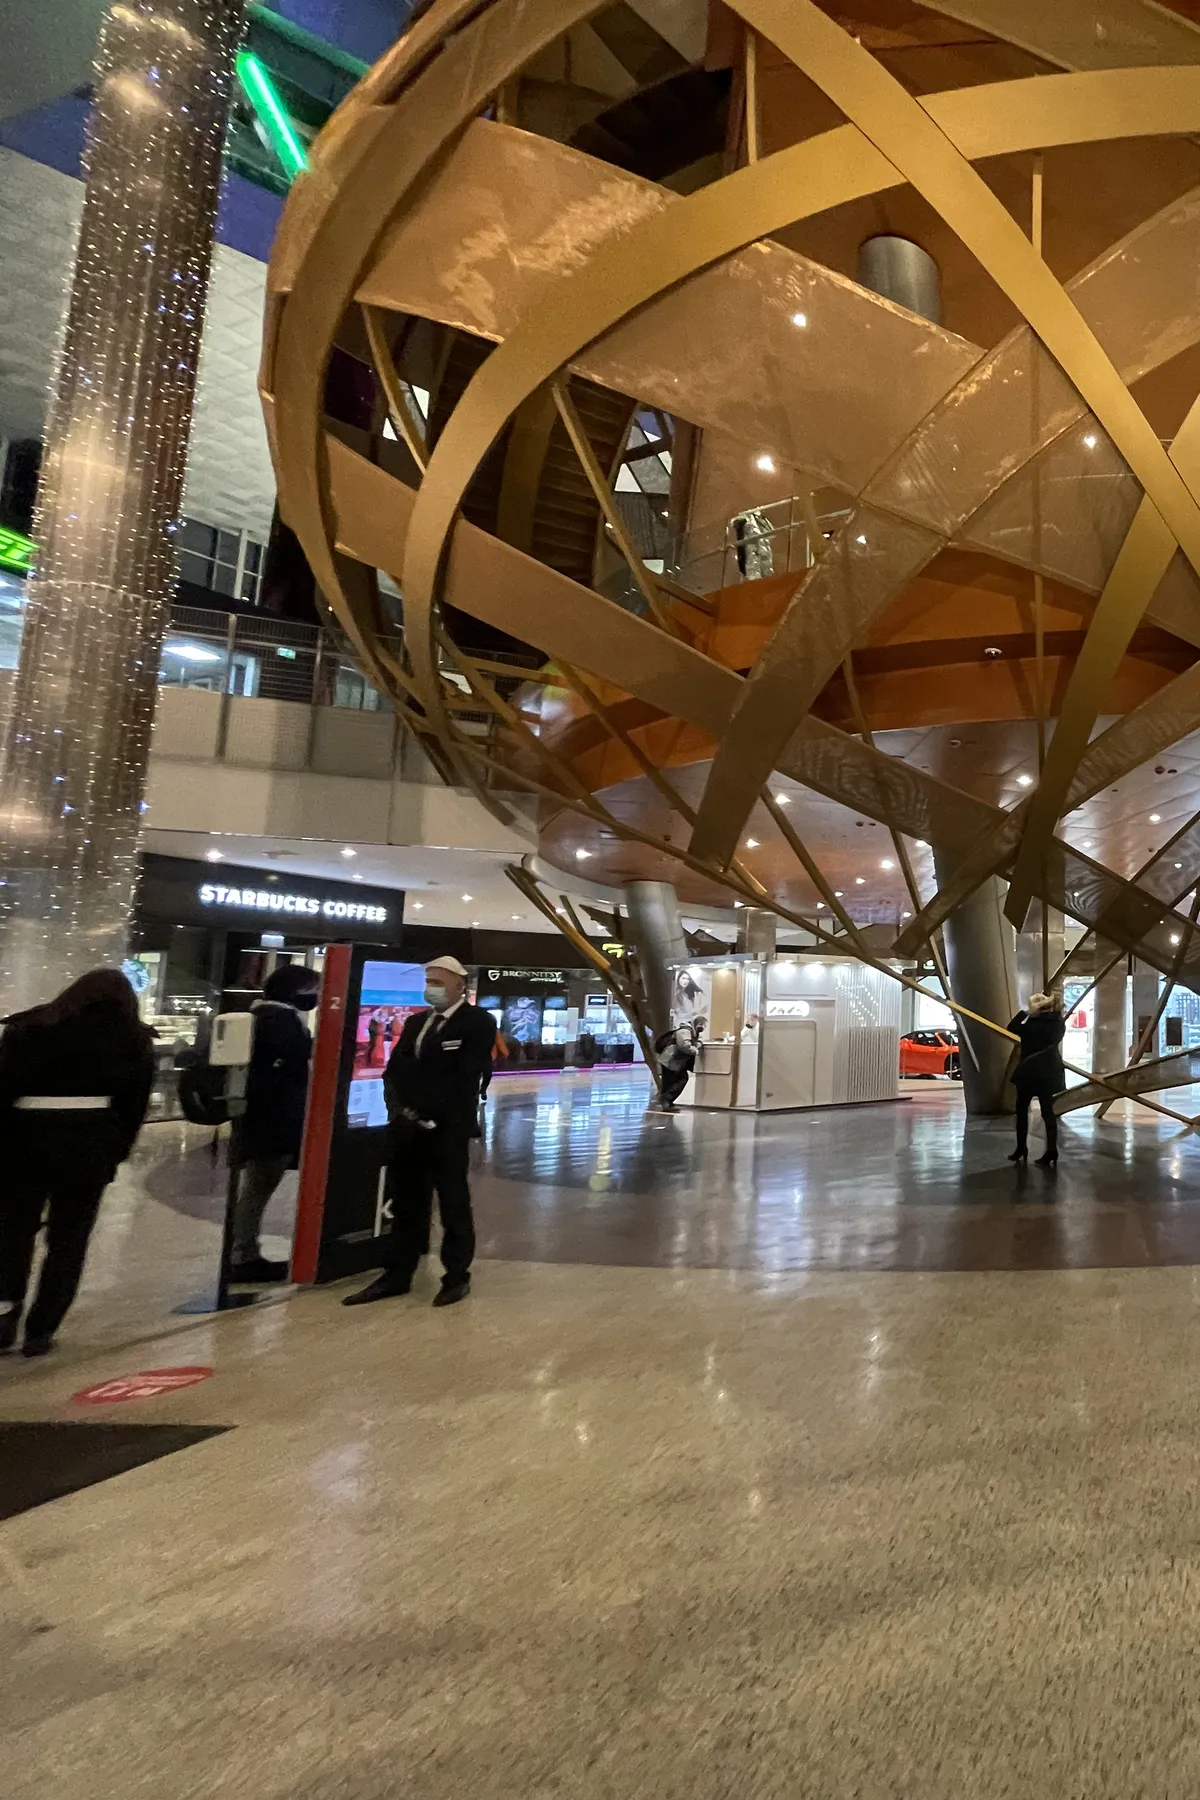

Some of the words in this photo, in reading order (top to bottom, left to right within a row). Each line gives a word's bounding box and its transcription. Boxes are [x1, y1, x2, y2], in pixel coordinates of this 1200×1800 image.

[200, 884, 320, 914] STARBUCKS
[322, 900, 387, 923] COFFEE
[502, 970, 563, 978] BRONNITSY
